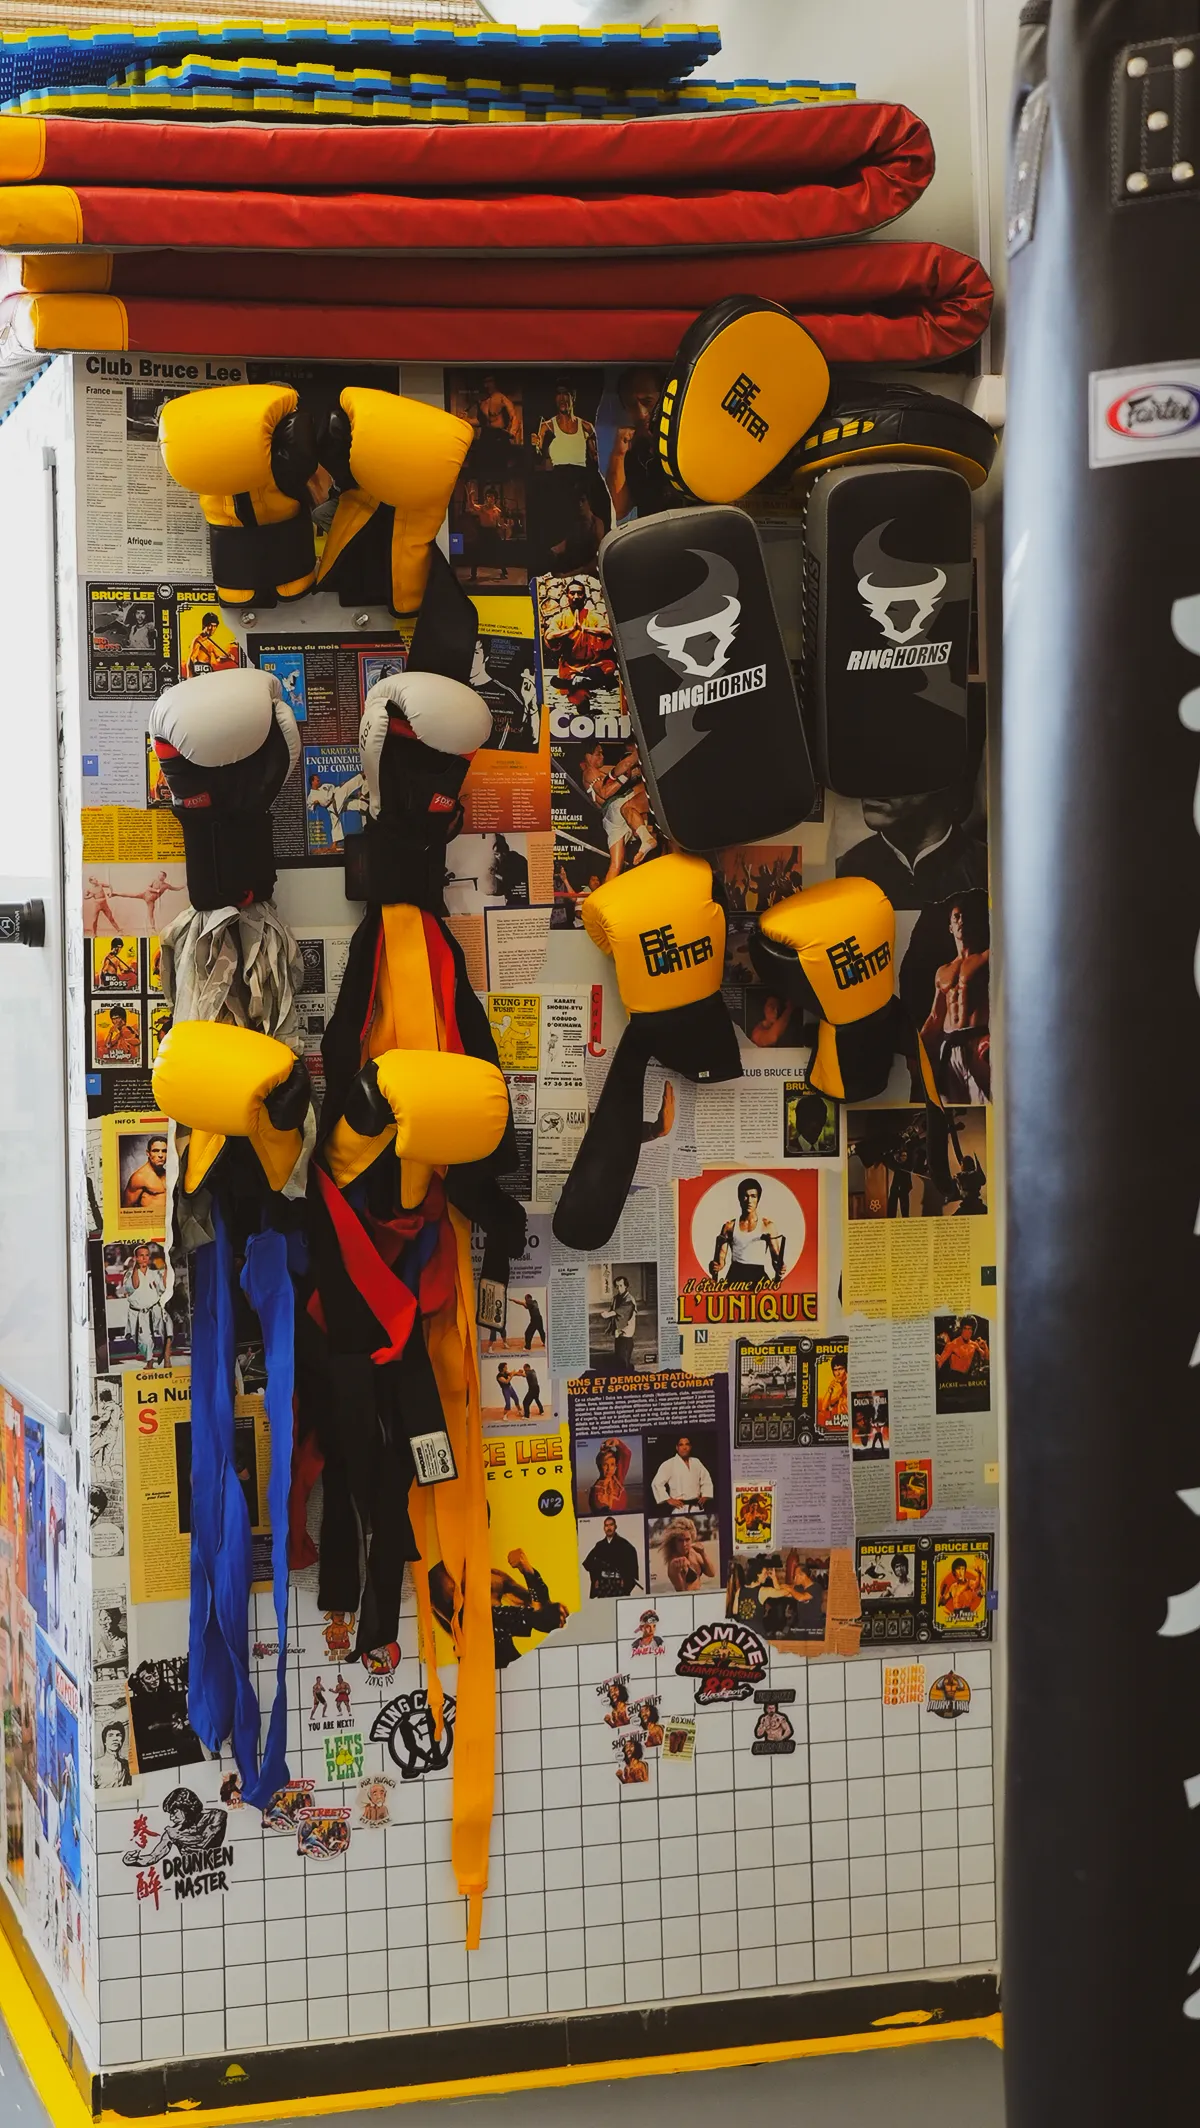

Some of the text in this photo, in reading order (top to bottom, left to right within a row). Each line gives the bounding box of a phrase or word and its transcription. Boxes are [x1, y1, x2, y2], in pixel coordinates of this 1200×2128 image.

[85, 357, 132, 376] Club
[139, 359, 199, 380] Bruce
[205, 362, 242, 382] Lee
[86, 386, 111, 395] France
[731, 372, 761, 403] BE
[720, 391, 770, 443] WATER
[127, 537, 152, 547] Afrique
[91, 592, 155, 601] BRUCE LEE
[176, 592, 215, 601] BRUCE
[162, 609, 171, 659] BRUCE LEE
[846, 641, 953, 671] RINGHORNS
[193, 664, 210, 673] BIG
[658, 663, 767, 716] RINGHORNS
[306, 755, 361, 765] ENCHAINEME
[317, 764, 330, 773] DE
[551, 814, 583, 822] FRANÇAISE
[639, 924, 677, 956] BE
[644, 935, 714, 977] WATER
[825, 935, 860, 966] BE
[833, 940, 892, 990] WATER
[493, 998, 536, 1007] KUNG FU
[742, 1067, 791, 1077] CLUB BRUCE
[785, 1083, 809, 1091] BRU
[683, 1276, 782, 1294] il était une fois
[677, 1292, 817, 1324] L'UNIQUE
[697, 1331, 706, 1343] N
[740, 1346, 797, 1356] BRUCE LEE
[816, 1345, 849, 1354] BRUCE
[135, 1371, 173, 1381] Contact
[594, 1377, 607, 1386] ET
[801, 1361, 809, 1408] BRUCE LEE
[592, 1385, 604, 1394] ET
[607, 1382, 650, 1393] SPORTS
[653, 1382, 667, 1390] DE
[671, 1378, 715, 1389] COMBAT
[137, 1387, 192, 1405] La Nui
[138, 1408, 159, 1435] S
[515, 1437, 564, 1465] LEE
[487, 1465, 563, 1481] ECTOR
[540, 1496, 562, 1509] N°2
[860, 1544, 916, 1555] BRUCE LEE
[934, 1541, 989, 1552] BRUCE LEE
[920, 1559, 928, 1576] LEE
[682, 1626, 764, 1667] KUMITE
[679, 1665, 762, 1680] CHAMPIONSHIP
[596, 1673, 631, 1696] SHO NUFF
[703, 1677, 734, 1695] 88
[627, 1695, 662, 1716] SHO NUFF
[927, 1700, 970, 1712] MUAY THAI
[308, 1718, 355, 1731] YOU ARE NEXT!
[374, 1698, 411, 1740] WING
[670, 1716, 695, 1726] BOXING
[324, 1733, 363, 1760] LETS
[612, 1731, 648, 1750] SHO NUFF
[327, 1756, 364, 1782] PLAY
[299, 1807, 352, 1820] STREETS
[162, 1845, 234, 1879] DRUNKEN
[174, 1871, 229, 1900] MASTER
